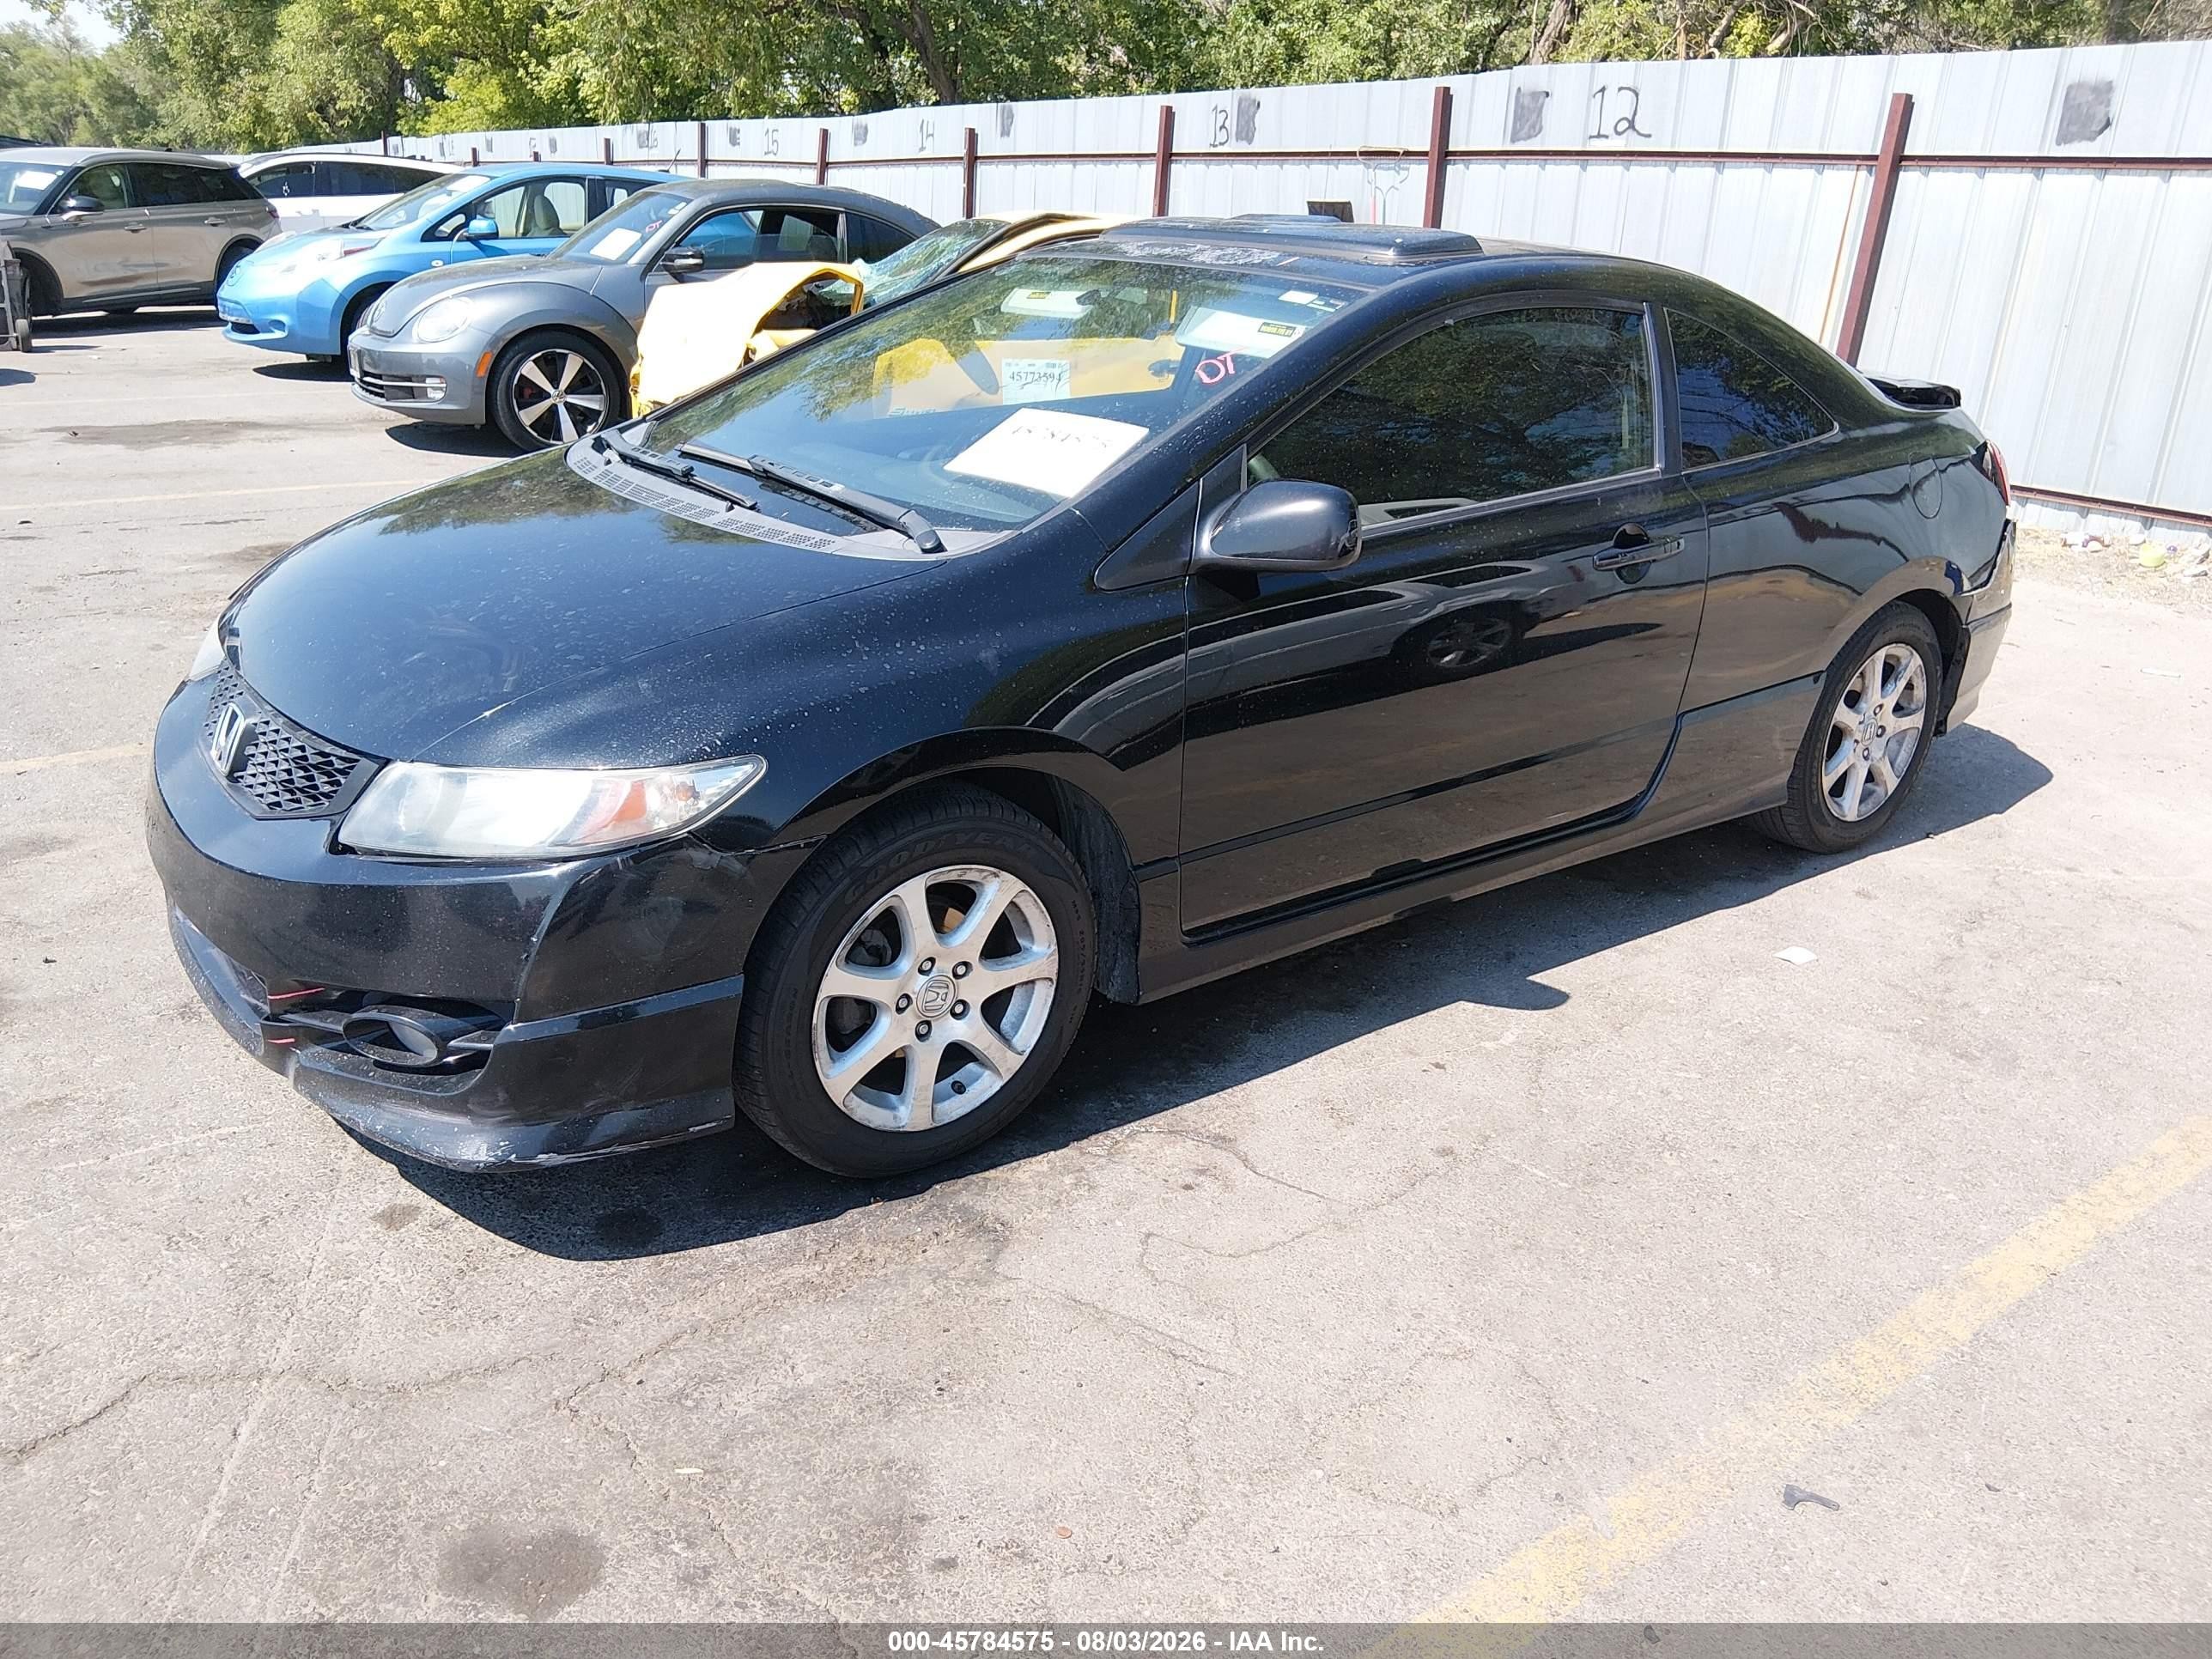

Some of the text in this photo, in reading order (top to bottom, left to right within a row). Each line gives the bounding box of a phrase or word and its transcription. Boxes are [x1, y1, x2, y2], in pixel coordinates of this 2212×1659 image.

[1209, 104, 1229, 148] 13
[1589, 85, 1652, 139] 12
[764, 129, 779, 156] 15
